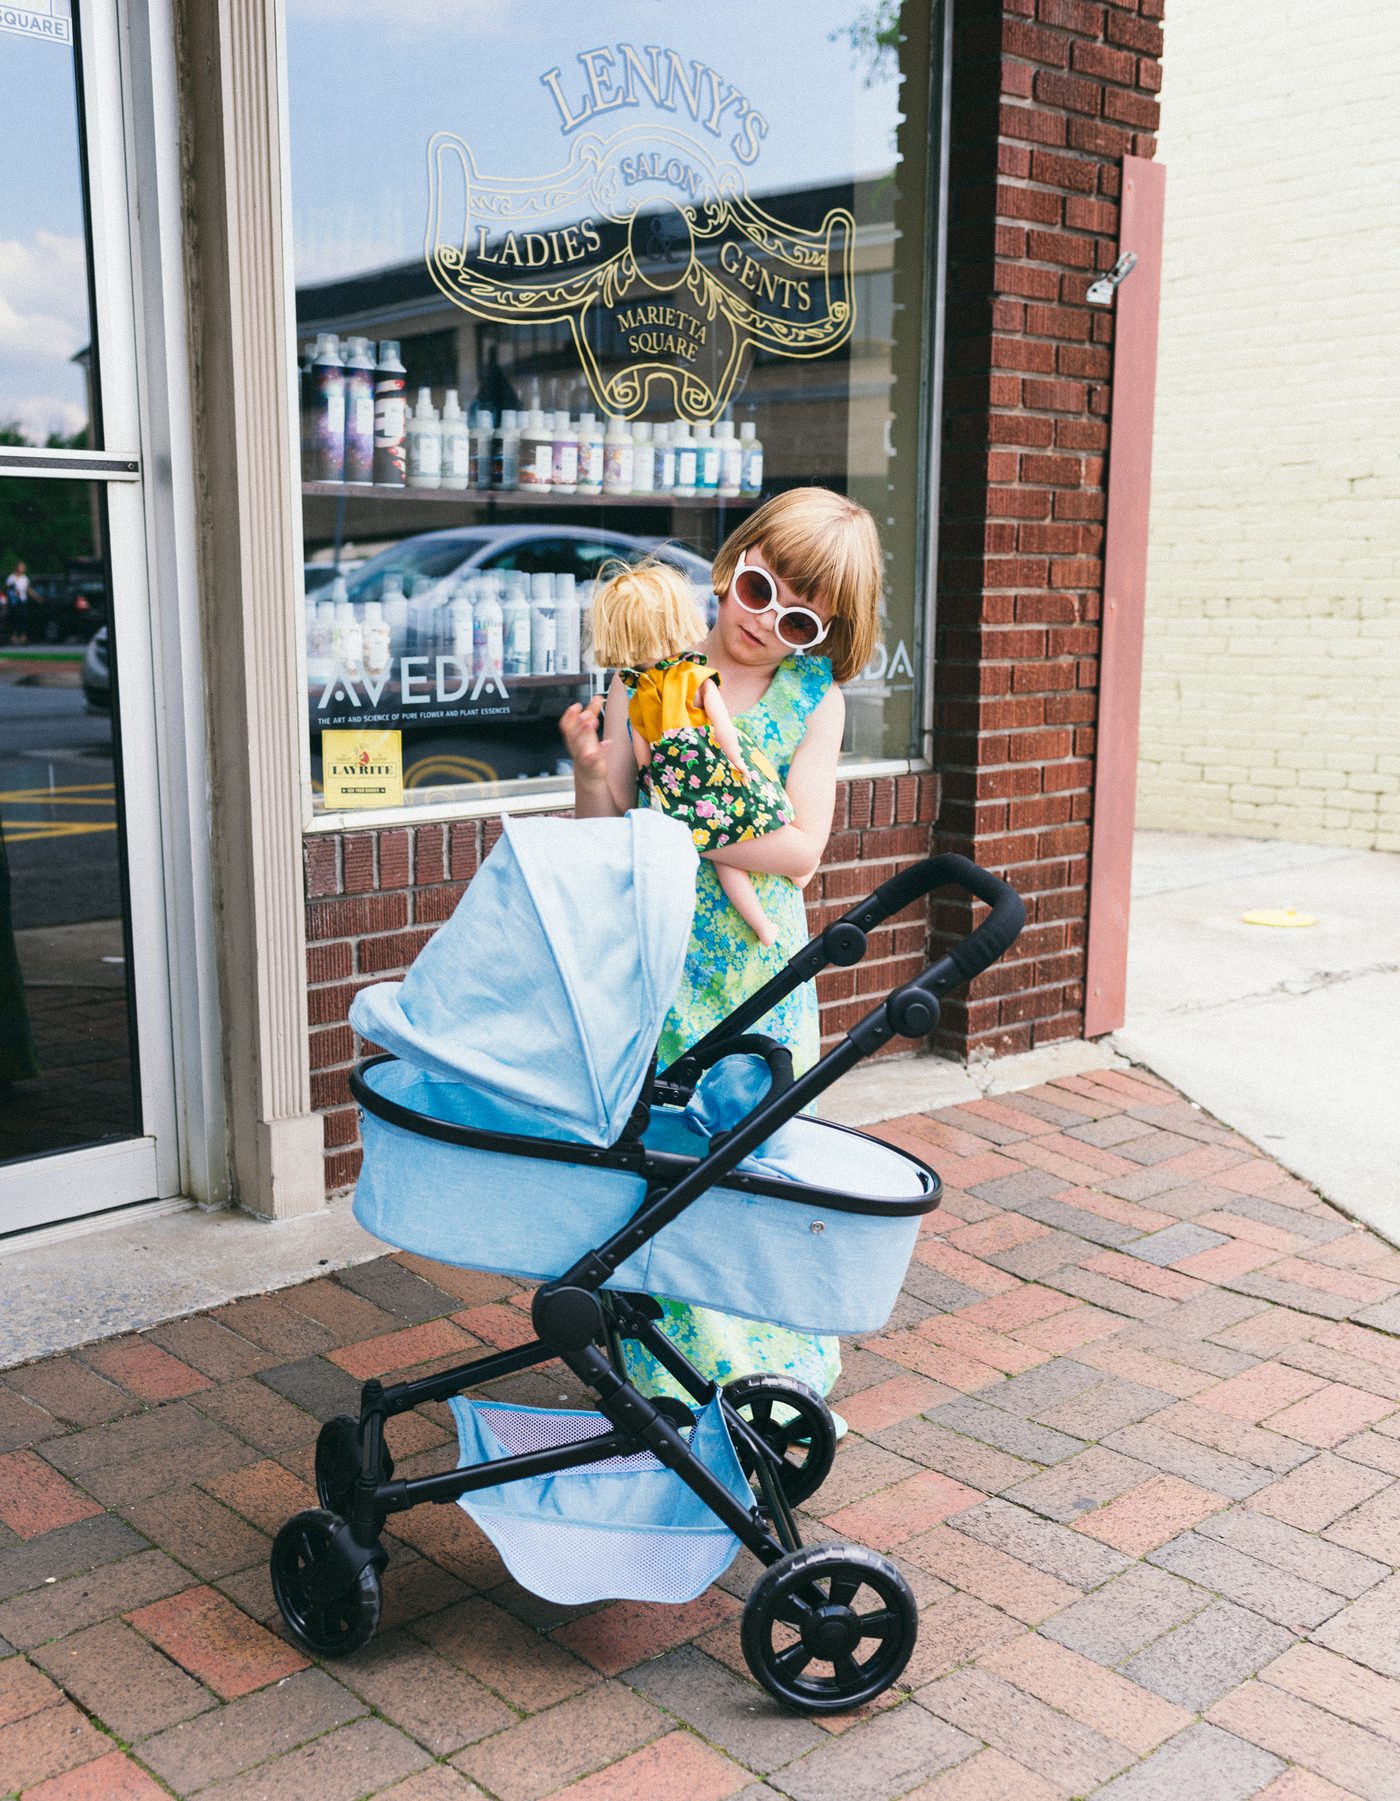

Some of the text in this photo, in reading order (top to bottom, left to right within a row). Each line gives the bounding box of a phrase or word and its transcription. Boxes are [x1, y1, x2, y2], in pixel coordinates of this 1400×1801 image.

[540, 43, 768, 165] LENNY'S
[620, 152, 702, 199] SALON
[476, 218, 601, 268] LADIES
[721, 241, 811, 311] GENTS
[617, 305, 707, 345] MARIETTA
[628, 332, 699, 362] SQUARE
[317, 655, 509, 709] AVEDA
[333, 716, 346, 724] ART
[363, 713, 390, 722] SCIENCE
[402, 712, 418, 720] PURE
[420, 711, 444, 719] FLOWER
[445, 709, 459, 717] AND
[460, 708, 479, 716] PLANT
[481, 706, 511, 715] ESSENCES
[332, 766, 394, 775] LAYRITE
